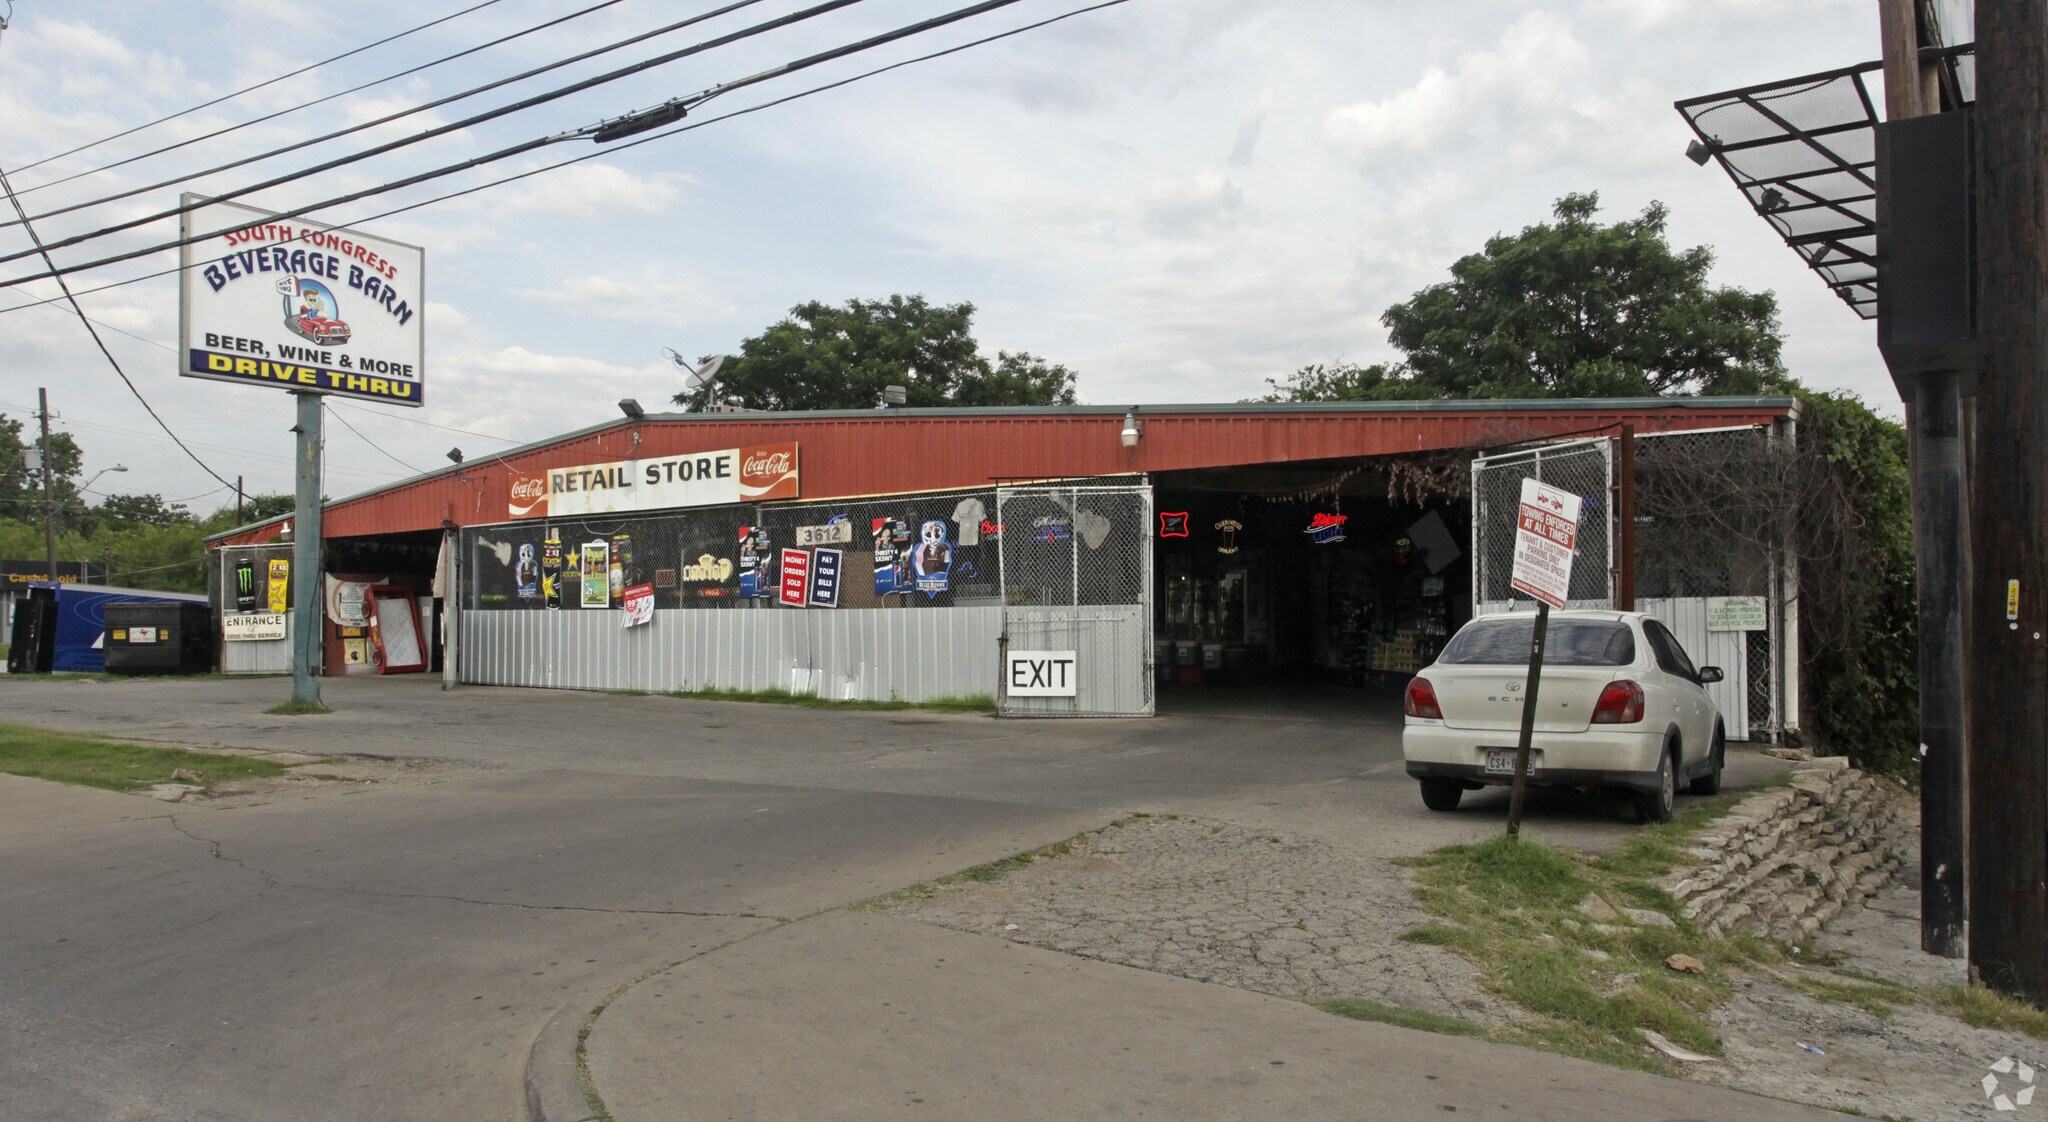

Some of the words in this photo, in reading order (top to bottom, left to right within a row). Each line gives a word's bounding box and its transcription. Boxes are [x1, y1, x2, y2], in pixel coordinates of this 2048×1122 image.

[223, 223, 293, 247] SOUTH
[300, 228, 398, 280] CONGRESS
[203, 247, 340, 293] BEVERAGE
[348, 265, 414, 326] BARN
[205, 332, 270, 358] BEER,
[278, 344, 332, 365] WINE
[339, 354, 353, 369] &
[360, 357, 414, 378] MORE
[208, 353, 318, 384] DRIVE
[326, 371, 412, 397] THRU
[742, 451, 791, 477] Coca-Cola
[552, 466, 632, 494] RETAIL
[645, 455, 731, 486] STORE
[511, 479, 544, 499] Coca-Cola
[1521, 504, 1545, 523] TOWING
[1545, 513, 1575, 536] ENFORCED
[804, 526, 841, 542] 3612
[1523, 517, 1534, 530] AT
[1533, 521, 1547, 537] ALL
[1549, 527, 1569, 545] TIMES
[1520, 531, 1539, 547] TENANT
[1543, 541, 1569, 559] CUSTOMER
[785, 556, 806, 565] MONEY
[821, 556, 834, 564] PAY
[1527, 544, 1548, 560] PARKING
[1548, 553, 1560, 565] ONLY
[784, 567, 806, 577] ORDERS
[819, 567, 835, 576] YOUR
[1550, 564, 1566, 579] SPACES
[786, 578, 801, 587] SOLD
[817, 578, 833, 587] BILLS
[786, 590, 800, 598] HERE
[816, 590, 831, 598] HERE
[226, 615, 282, 627] ENTRANCE
